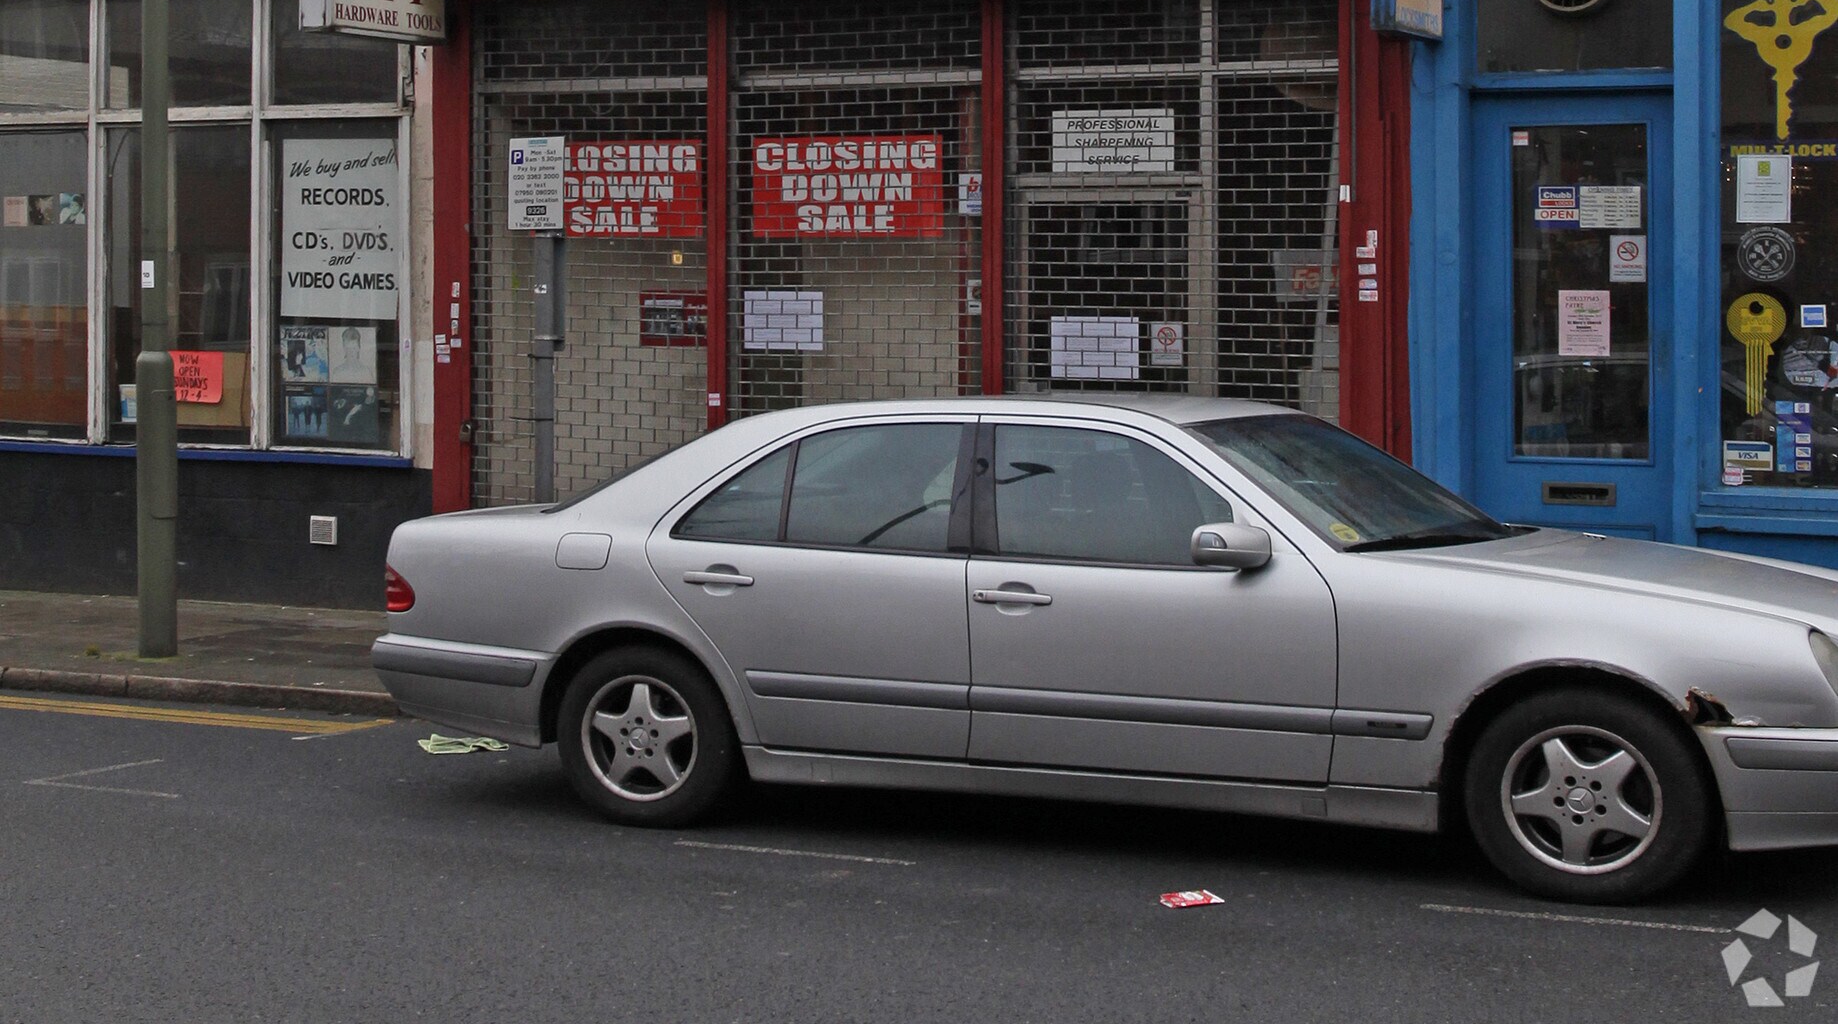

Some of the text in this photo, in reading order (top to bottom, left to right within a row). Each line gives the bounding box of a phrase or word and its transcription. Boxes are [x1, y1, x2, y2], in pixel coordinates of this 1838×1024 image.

[335, 3, 442, 32] HARDWARE TOOLS
[1067, 119, 1160, 130] PROFESSIONAL
[1074, 137, 1154, 147] SHARPENING
[289, 148, 396, 178] We buy and sell
[755, 141, 937, 172] CLOSING
[1088, 154, 1140, 165] SERVICE
[564, 175, 674, 202] DOWN
[781, 173, 913, 202] DOWN
[1543, 191, 1572, 199] Chubb
[570, 206, 660, 233] SALE
[798, 205, 895, 233] SALE
[1540, 210, 1575, 219] OPEN
[288, 272, 334, 290] VIDEO
[179, 355, 199, 364] NOW
[179, 366, 200, 377] OPEN
[1738, 451, 1758, 459] VISA
